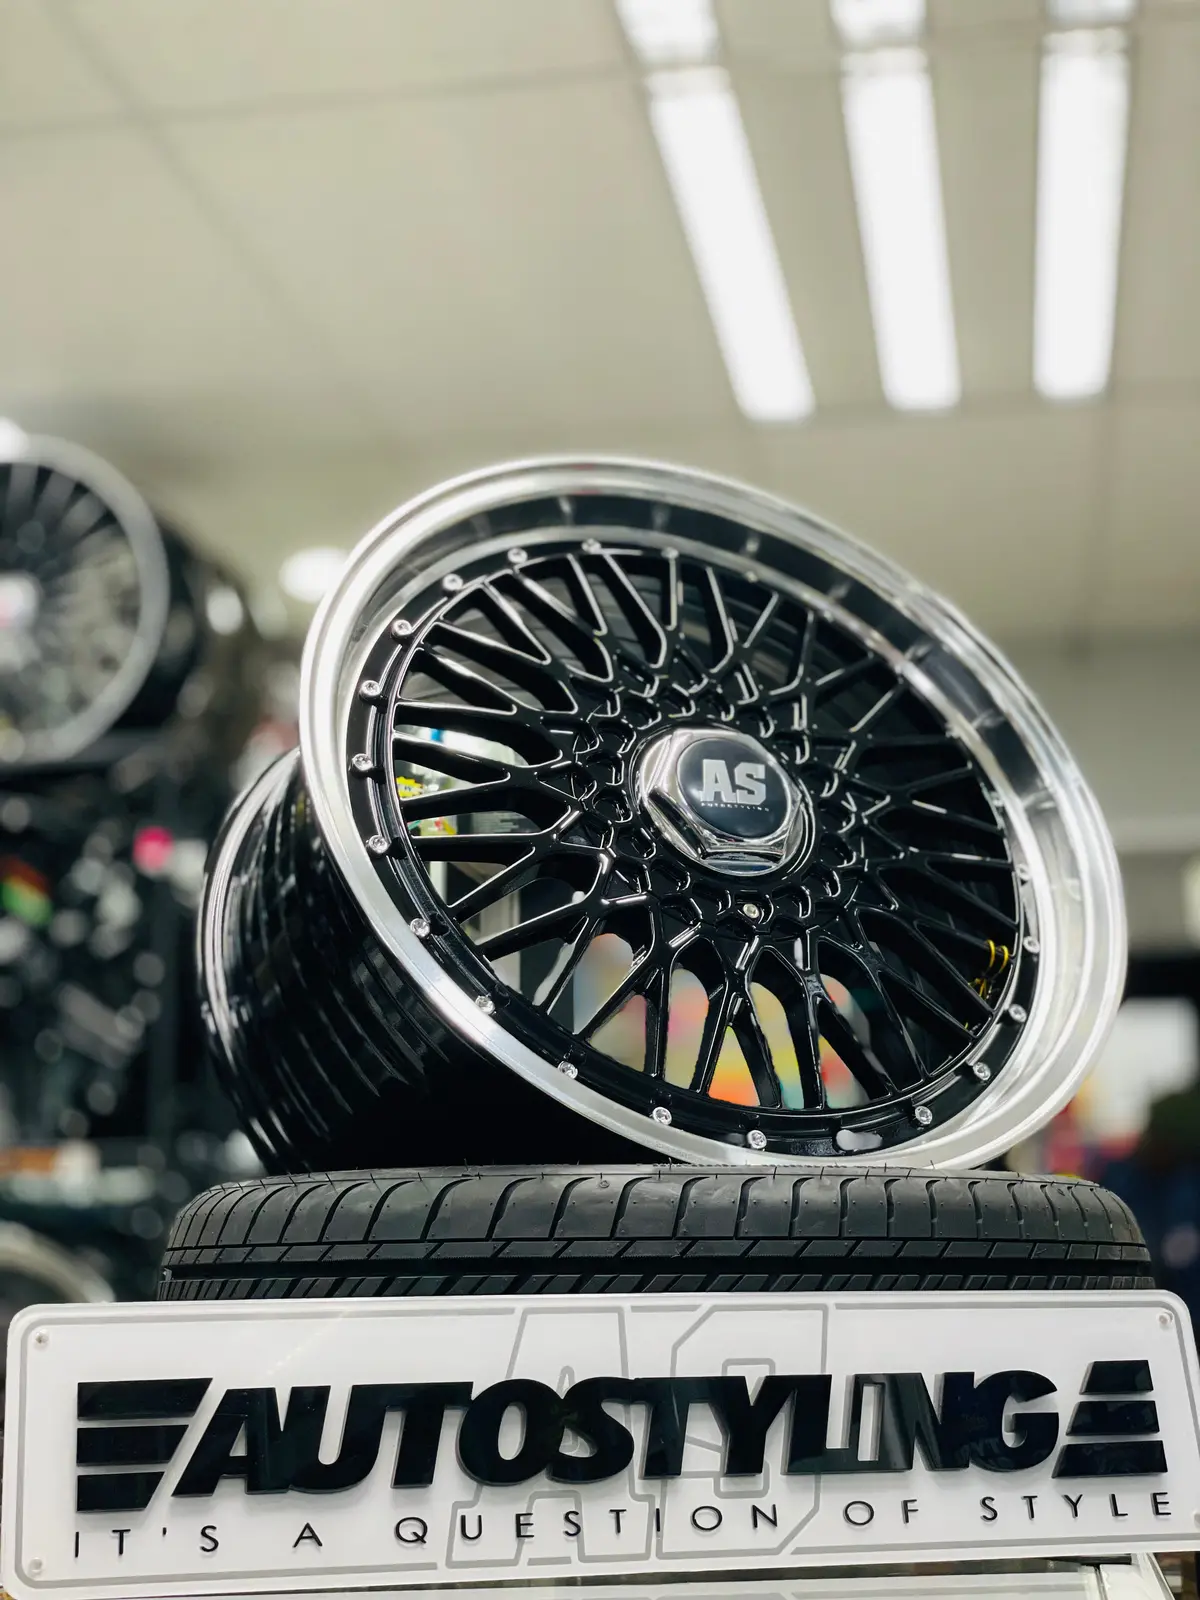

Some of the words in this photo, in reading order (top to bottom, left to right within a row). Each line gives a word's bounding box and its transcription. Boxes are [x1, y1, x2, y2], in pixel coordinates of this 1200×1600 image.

[699, 758, 766, 806] AS
[171, 1368, 1060, 1498] AUTOSTYLING
[73, 1524, 219, 1559] IT'S
[293, 1522, 323, 1549] A
[394, 1503, 779, 1546] QUESTION
[844, 1499, 919, 1526] OF
[980, 1492, 1172, 1522] STYLE
